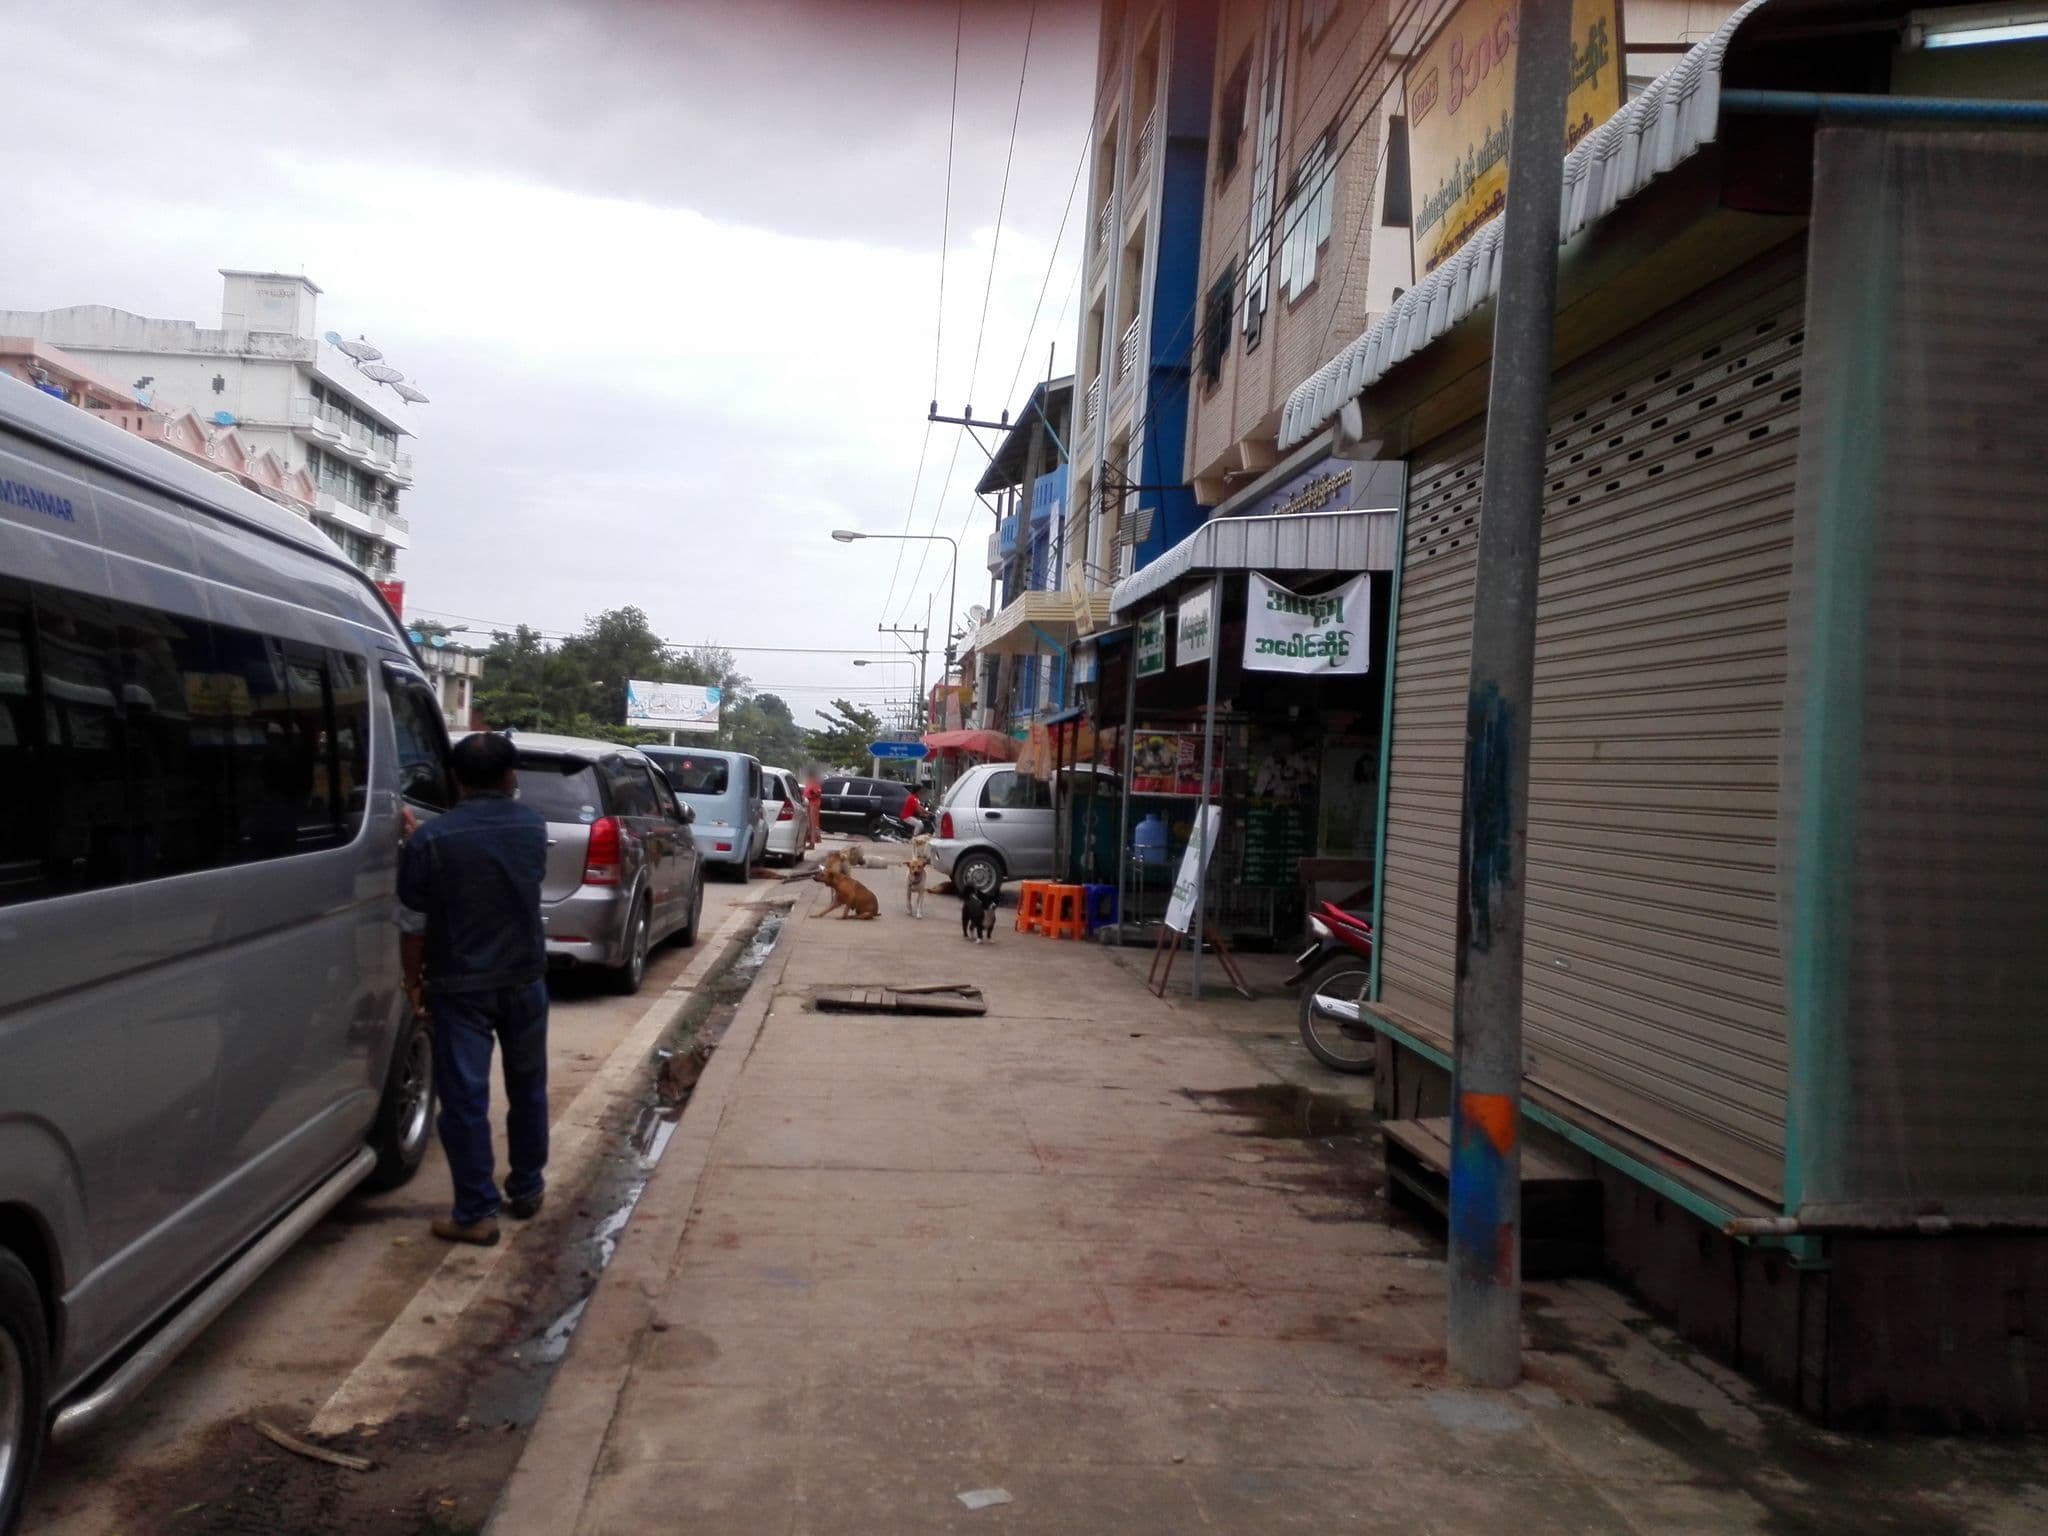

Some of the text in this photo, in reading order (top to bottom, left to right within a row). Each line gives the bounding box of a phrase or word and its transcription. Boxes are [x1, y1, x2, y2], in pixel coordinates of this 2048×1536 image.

[0, 478, 75, 522] MYANMAR
[1255, 630, 1355, 667] အပေါင်ဆိုင်
